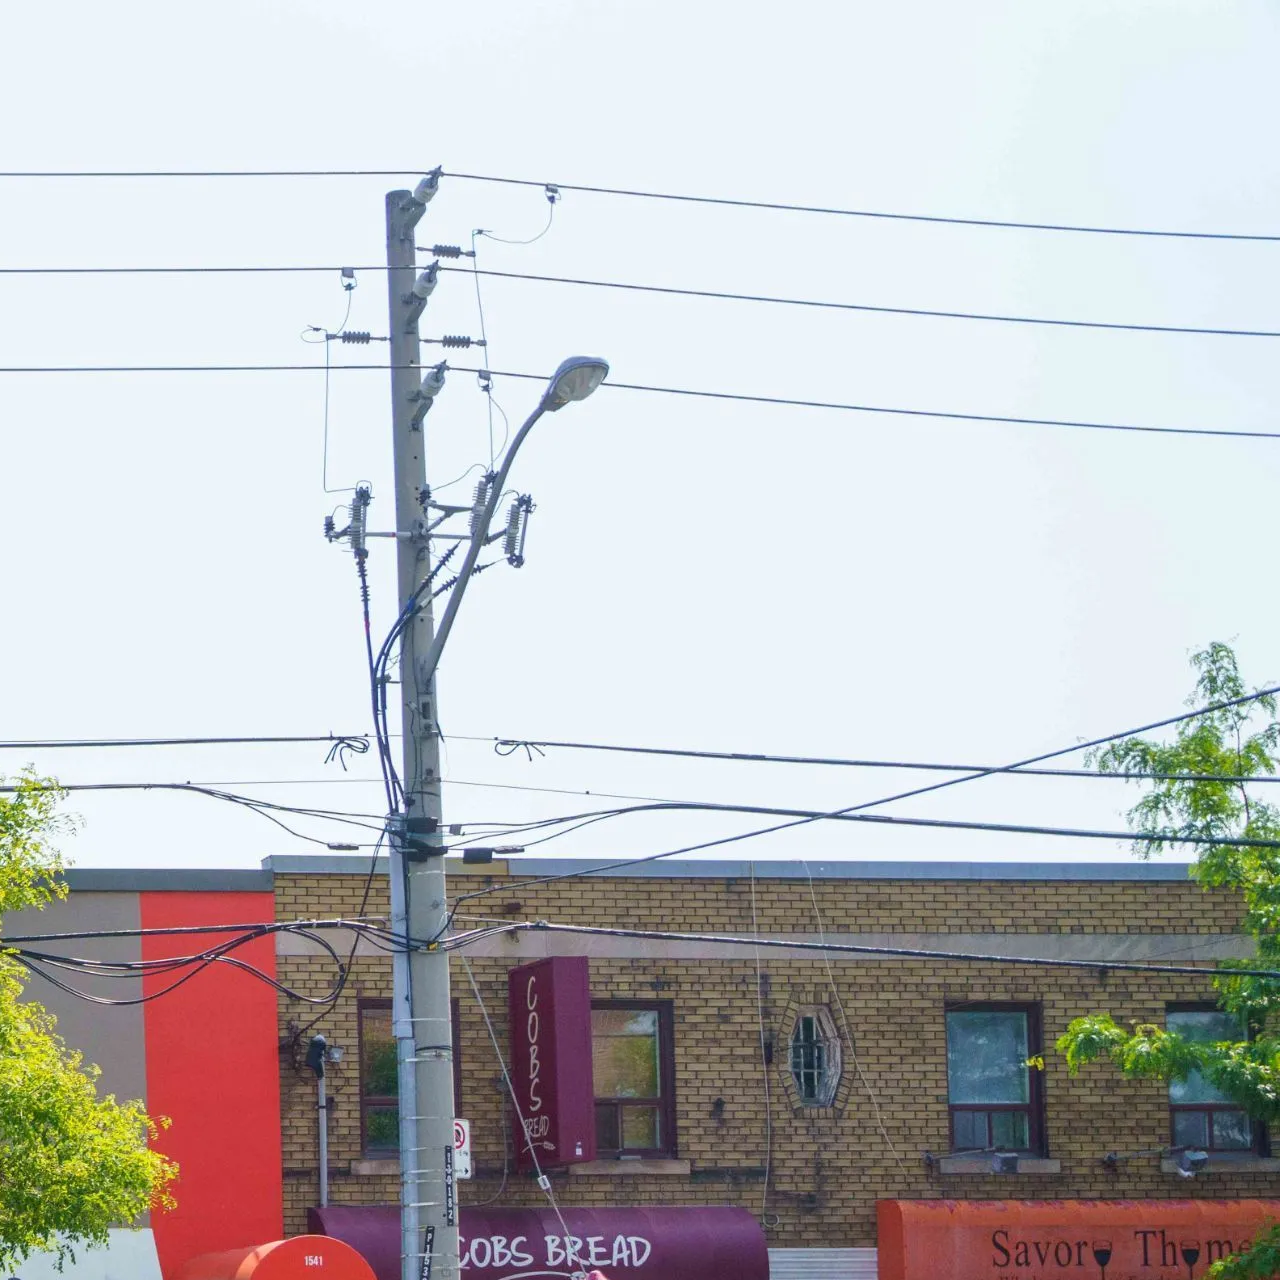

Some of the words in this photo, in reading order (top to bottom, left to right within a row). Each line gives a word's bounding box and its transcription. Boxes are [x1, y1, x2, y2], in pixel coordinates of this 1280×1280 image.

[527, 976, 542, 1112] COBS
[304, 1255, 323, 1266] 1541
[544, 1233, 652, 1268] BREAD
